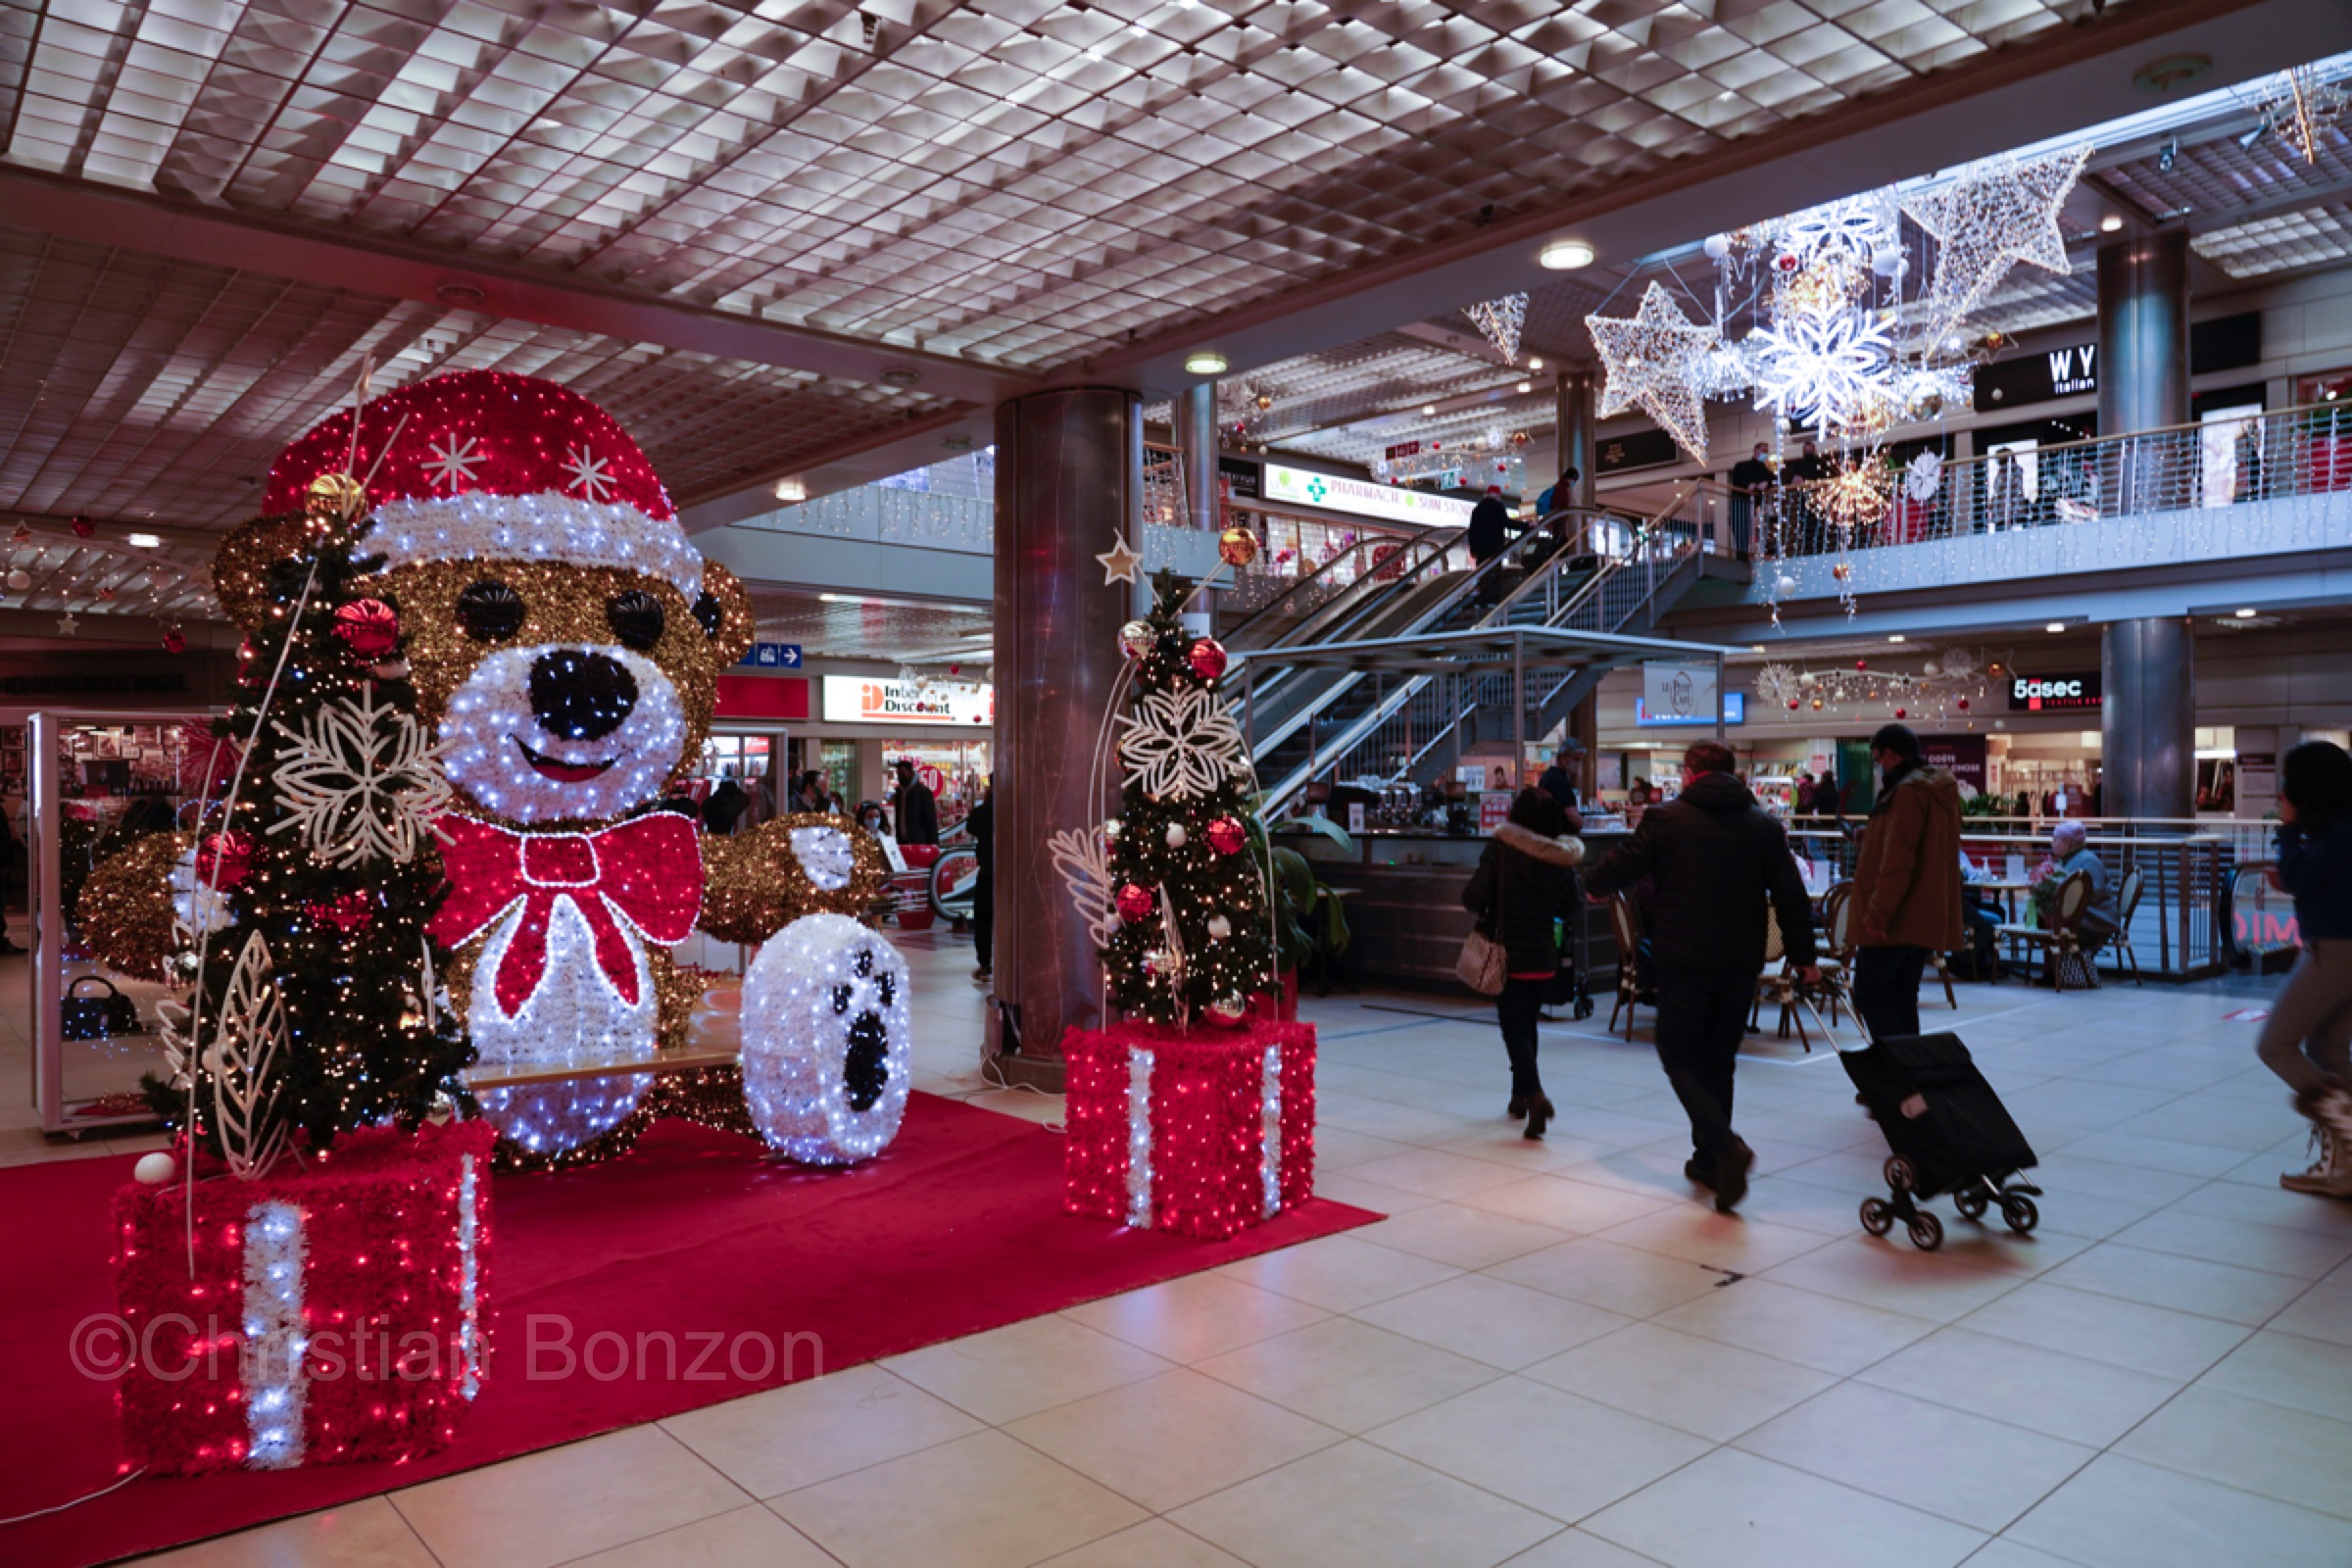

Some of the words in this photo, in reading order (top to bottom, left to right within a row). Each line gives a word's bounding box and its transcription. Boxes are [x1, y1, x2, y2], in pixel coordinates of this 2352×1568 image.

[1330, 479, 1401, 504] PHARMACIE
[1443, 500, 1471, 515] STOR
[2015, 678, 2082, 700] 5asec
[885, 700, 950, 714] Discnt
